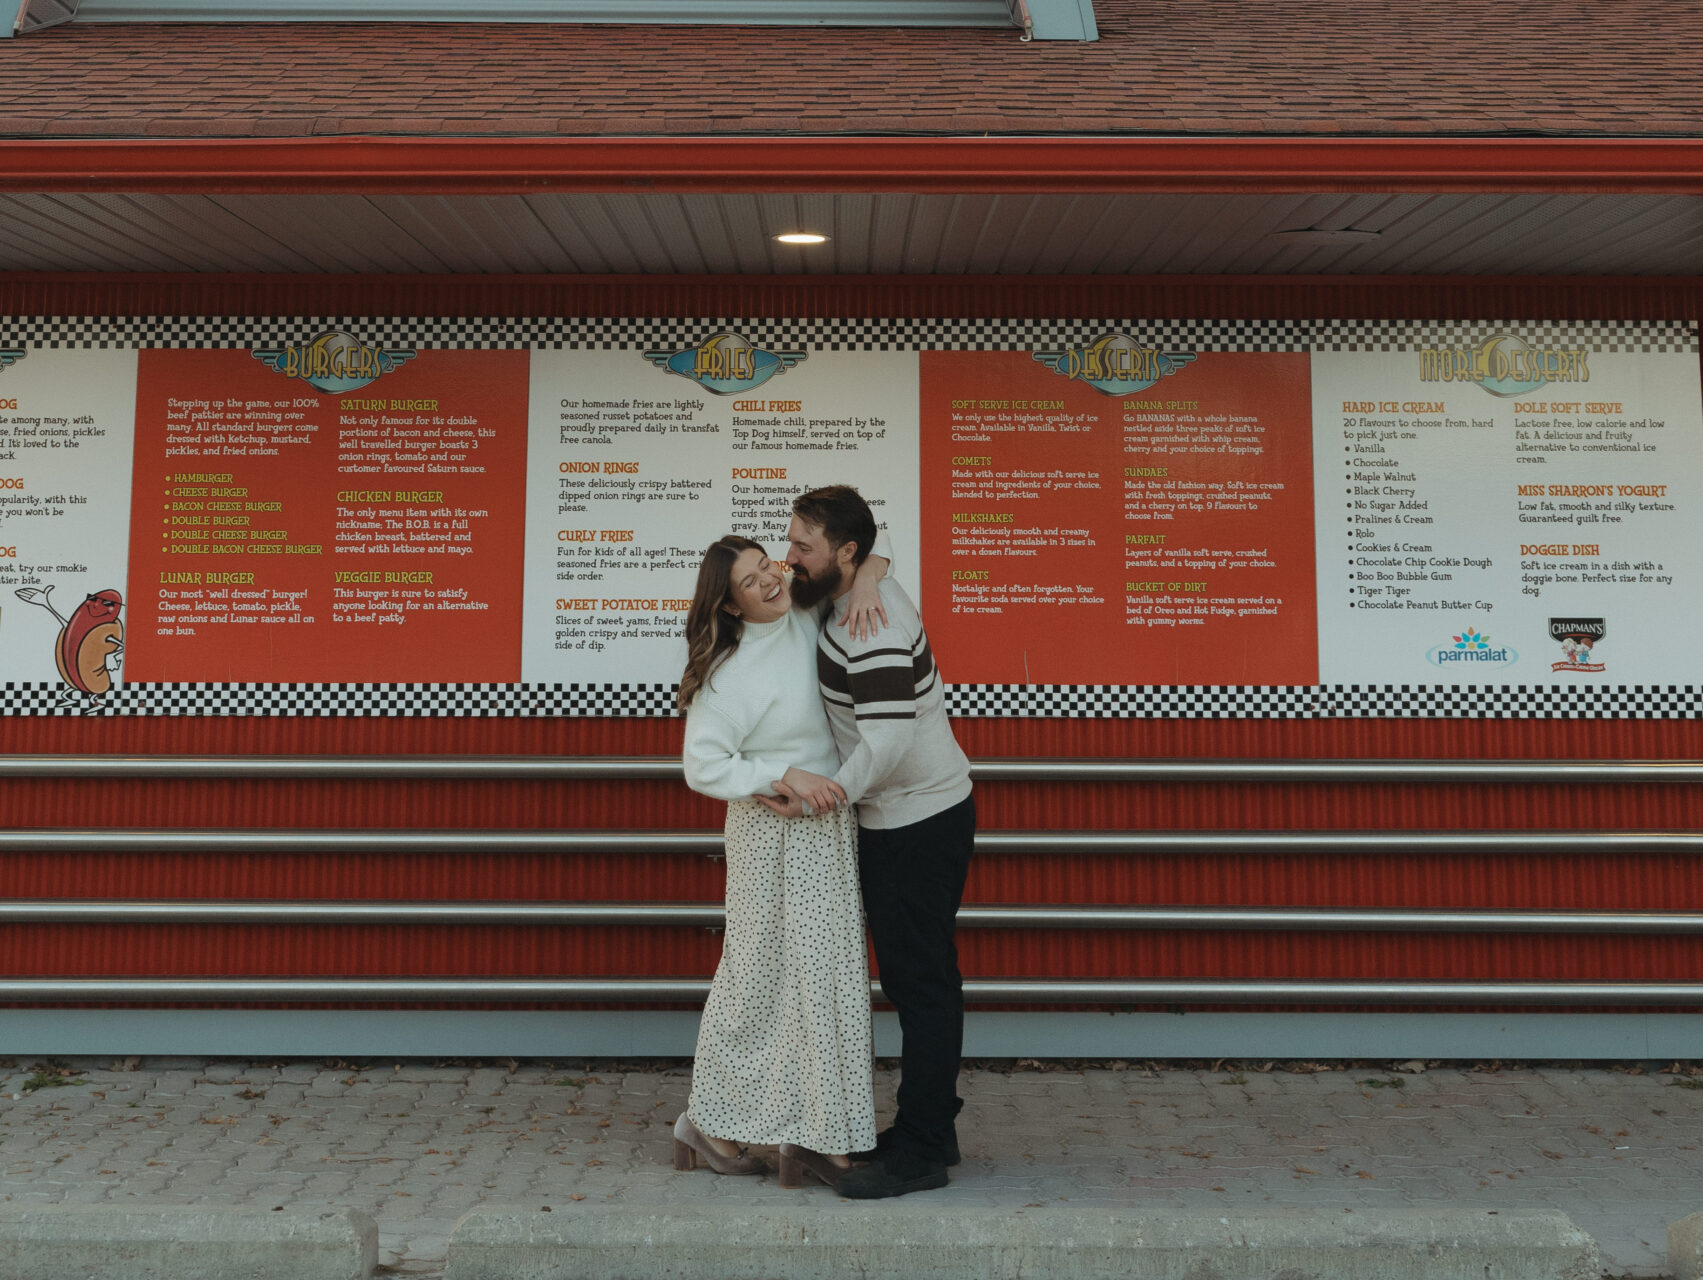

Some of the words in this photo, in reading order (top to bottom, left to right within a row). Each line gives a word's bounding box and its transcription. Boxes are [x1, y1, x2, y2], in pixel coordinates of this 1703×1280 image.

[282, 345, 382, 378] BURGERS
[693, 348, 754, 380] FRIES
[1068, 348, 1160, 381] DESSERTS
[1419, 349, 1484, 381] MORE
[1496, 349, 1589, 381] DESSERTS
[341, 400, 386, 411] SATURN
[390, 400, 438, 412] BURGER
[561, 398, 579, 408] Our
[582, 398, 630, 408] homemade
[633, 399, 653, 409] fries
[656, 401, 671, 409] are
[674, 399, 704, 412] lightly
[733, 400, 766, 412] CHILI
[768, 400, 802, 413] FRIES
[952, 400, 976, 408] SOFT
[979, 400, 1009, 410] SERVE
[1012, 400, 1028, 409] ICE
[1030, 400, 1064, 410] CREAM
[1124, 401, 1163, 410] BANANA
[1166, 401, 1198, 410] SPLITS
[1342, 401, 1376, 414] HARD
[1379, 402, 1399, 413] ICE
[1402, 402, 1444, 414] CREAM
[1514, 402, 1548, 414] DOLE
[1550, 402, 1582, 414] SOFT
[1585, 402, 1622, 415] SERVE
[560, 410, 600, 420] seasoned
[603, 410, 630, 420] russet
[633, 410, 673, 423] potatoes
[676, 411, 692, 421] and
[732, 416, 781, 426] Homemade
[809, 416, 852, 429] prepared
[855, 416, 866, 429] by
[870, 417, 885, 427] the
[1343, 417, 1356, 427] 20
[1359, 417, 1396, 427] flavours
[1398, 417, 1409, 427] to
[1412, 417, 1442, 427] choose
[1445, 418, 1469, 428] from,
[1472, 418, 1494, 428] hard
[1354, 443, 1385, 453] Vanilla
[952, 456, 991, 465] COMETS
[1353, 457, 1398, 467] Chocolate
[560, 462, 600, 473] ONION
[604, 462, 639, 474] RINGS
[732, 468, 786, 479] POUTINE
[1124, 468, 1168, 476] SUNDAES
[174, 474, 232, 483] HAMBURGER
[1354, 471, 1380, 484] Maple
[1384, 471, 1416, 481] Walnut
[559, 478, 585, 488] These
[588, 478, 636, 491] deliciously
[639, 478, 667, 491] crispy
[671, 478, 712, 488] battered
[173, 488, 208, 496] CHEESE
[211, 488, 248, 498] BURGER
[337, 491, 391, 502] CHICKEN
[396, 491, 443, 503] BURGER
[952, 489, 983, 498] blended
[985, 489, 994, 498] to
[1354, 485, 1380, 495] Black
[1383, 485, 1415, 498] Cherry
[1518, 485, 1545, 496] MISS
[1616, 485, 1667, 498] YOGURT
[172, 502, 204, 510] BACON
[207, 502, 242, 511] CHEESE
[245, 502, 282, 512] BURGER
[1355, 499, 1367, 509] No
[1370, 500, 1396, 513] Sugar
[1399, 500, 1428, 510] Added
[1518, 501, 1537, 511] Low
[1541, 501, 1556, 511] fat,
[1559, 501, 1592, 511] smooth
[1595, 501, 1612, 511] and
[1615, 501, 1636, 514] silky
[1639, 501, 1676, 511] texture.
[172, 516, 210, 525] DOUBLE
[213, 516, 250, 526] BURGER
[952, 513, 1013, 522] MILKSHAKES
[1355, 514, 1392, 524] Pralines
[1395, 514, 1401, 524] &
[1404, 514, 1433, 524] Cream
[1519, 513, 1573, 523] Guaranteed
[1576, 513, 1599, 526] guilt
[1602, 513, 1621, 523] free.
[171, 530, 209, 539] DOUBLE
[212, 530, 248, 539] CHEESE
[250, 531, 288, 540] BURGER
[558, 530, 596, 543] CURLY
[600, 530, 634, 543] FRIES
[1355, 528, 1374, 538] Rolo
[1126, 535, 1166, 545] PARFAIT
[171, 544, 209, 553] DOUBLE
[212, 545, 244, 553] BACON
[247, 545, 282, 554] CHEESE
[285, 545, 322, 554] BURGER
[1356, 542, 1391, 552] Cookies
[1394, 542, 1400, 552] &
[1402, 542, 1432, 552] Cream
[1520, 544, 1569, 556] DOGGIE
[1572, 544, 1600, 556] DISH
[19, 562, 34, 575] try
[37, 565, 53, 573] our
[56, 563, 87, 573] smokie
[1356, 556, 1402, 566] Chocolate
[1405, 556, 1426, 569] Chip
[1430, 557, 1460, 567] Cookie
[1464, 557, 1492, 570] Dough
[160, 572, 201, 584] LUNAR
[206, 573, 254, 584] BURGER
[335, 572, 381, 582] VEGGIE
[385, 572, 433, 584] BURGER
[952, 570, 988, 580] FLOATS
[1357, 571, 1374, 581] Boo
[1377, 571, 1394, 581] Boo
[1397, 571, 1428, 581] Bubble
[1431, 571, 1452, 581] Gum
[1126, 582, 1165, 591] BUCKET
[1168, 582, 1181, 591] OF
[1184, 582, 1207, 592] DIRT
[1357, 585, 1382, 598] Tiger
[1385, 585, 1411, 598] Tiger
[159, 588, 178, 598] Our
[181, 589, 203, 599] most
[272, 589, 307, 602] burger!
[334, 588, 354, 598] This
[356, 588, 389, 601] burger
[392, 588, 399, 598] is
[402, 590, 421, 598] sure
[424, 588, 435, 598] to
[438, 588, 468, 601] satisfy
[556, 599, 598, 610] SWEET
[602, 599, 658, 610] POTATOE
[1358, 599, 1404, 609] Chocolate
[1406, 599, 1438, 609] Peanut
[1441, 599, 1472, 609] Butter
[1475, 599, 1493, 612] Cup
[1126, 616, 1145, 625] with
[1147, 618, 1176, 627] gummy
[1552, 623, 1604, 635] CHAPMAN'S
[1438, 648, 1507, 664] parmalat
